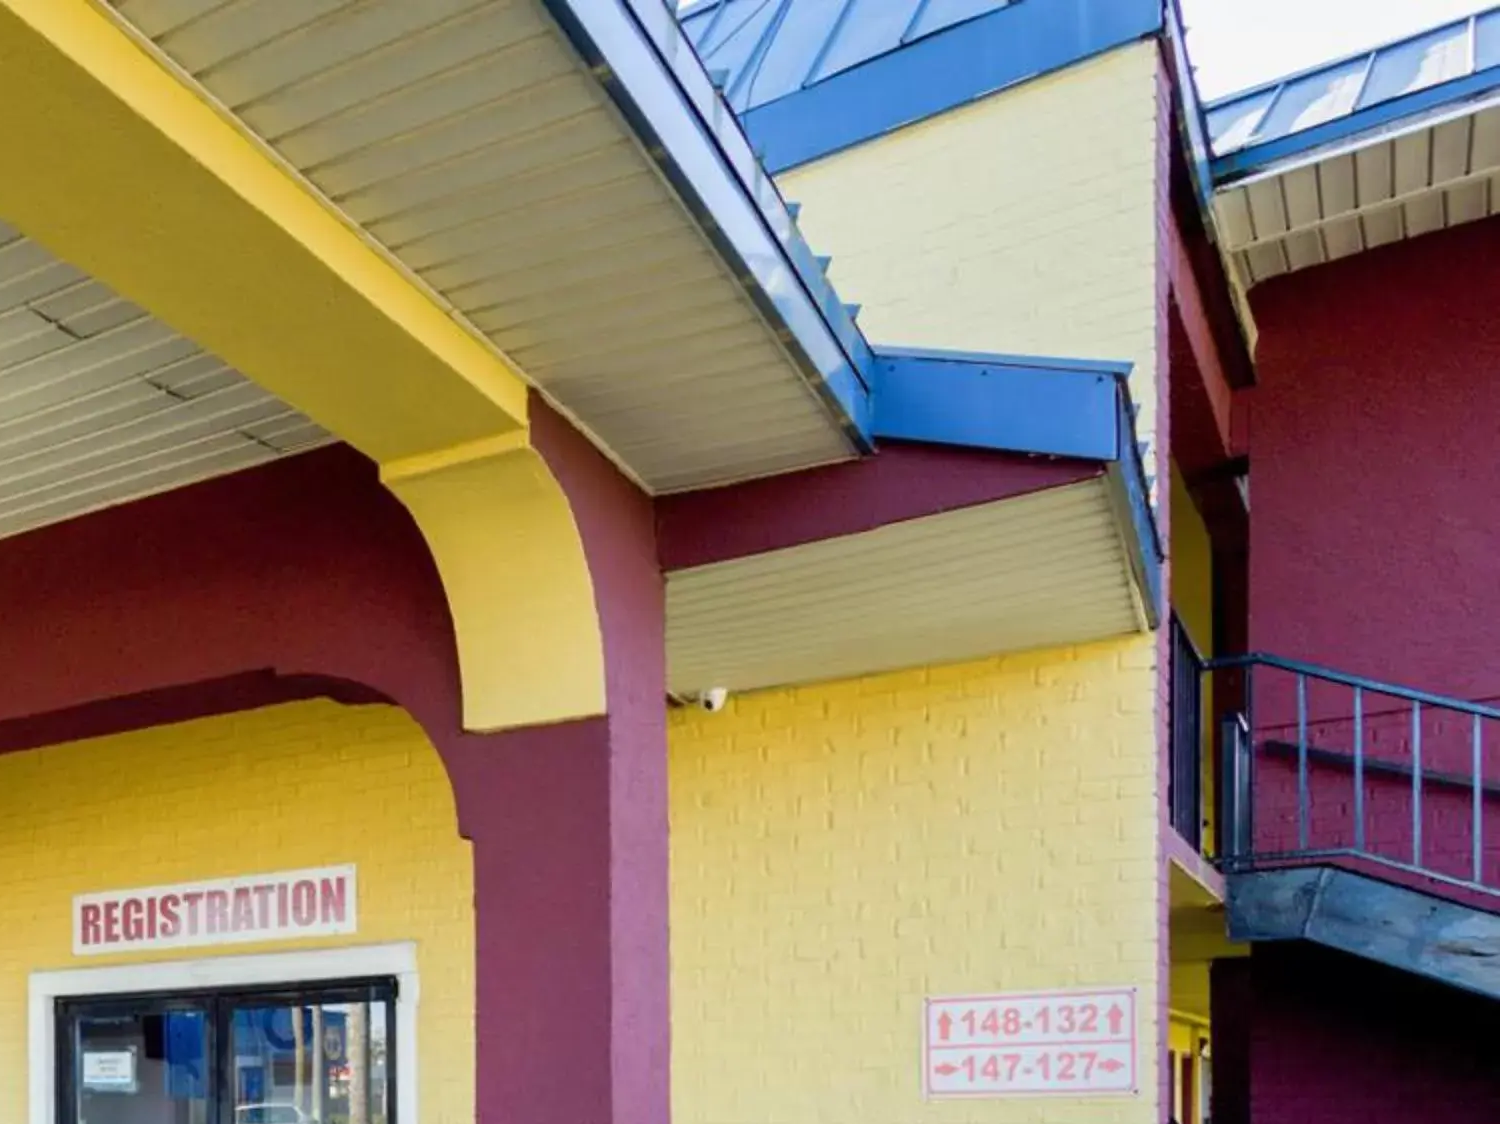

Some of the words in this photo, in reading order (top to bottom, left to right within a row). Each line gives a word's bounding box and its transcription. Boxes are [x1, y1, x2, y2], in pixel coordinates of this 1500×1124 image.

[81, 877, 346, 945] REGISTRATION
[961, 1004, 1099, 1036] 148-132
[961, 1053, 1099, 1082] 147-127
